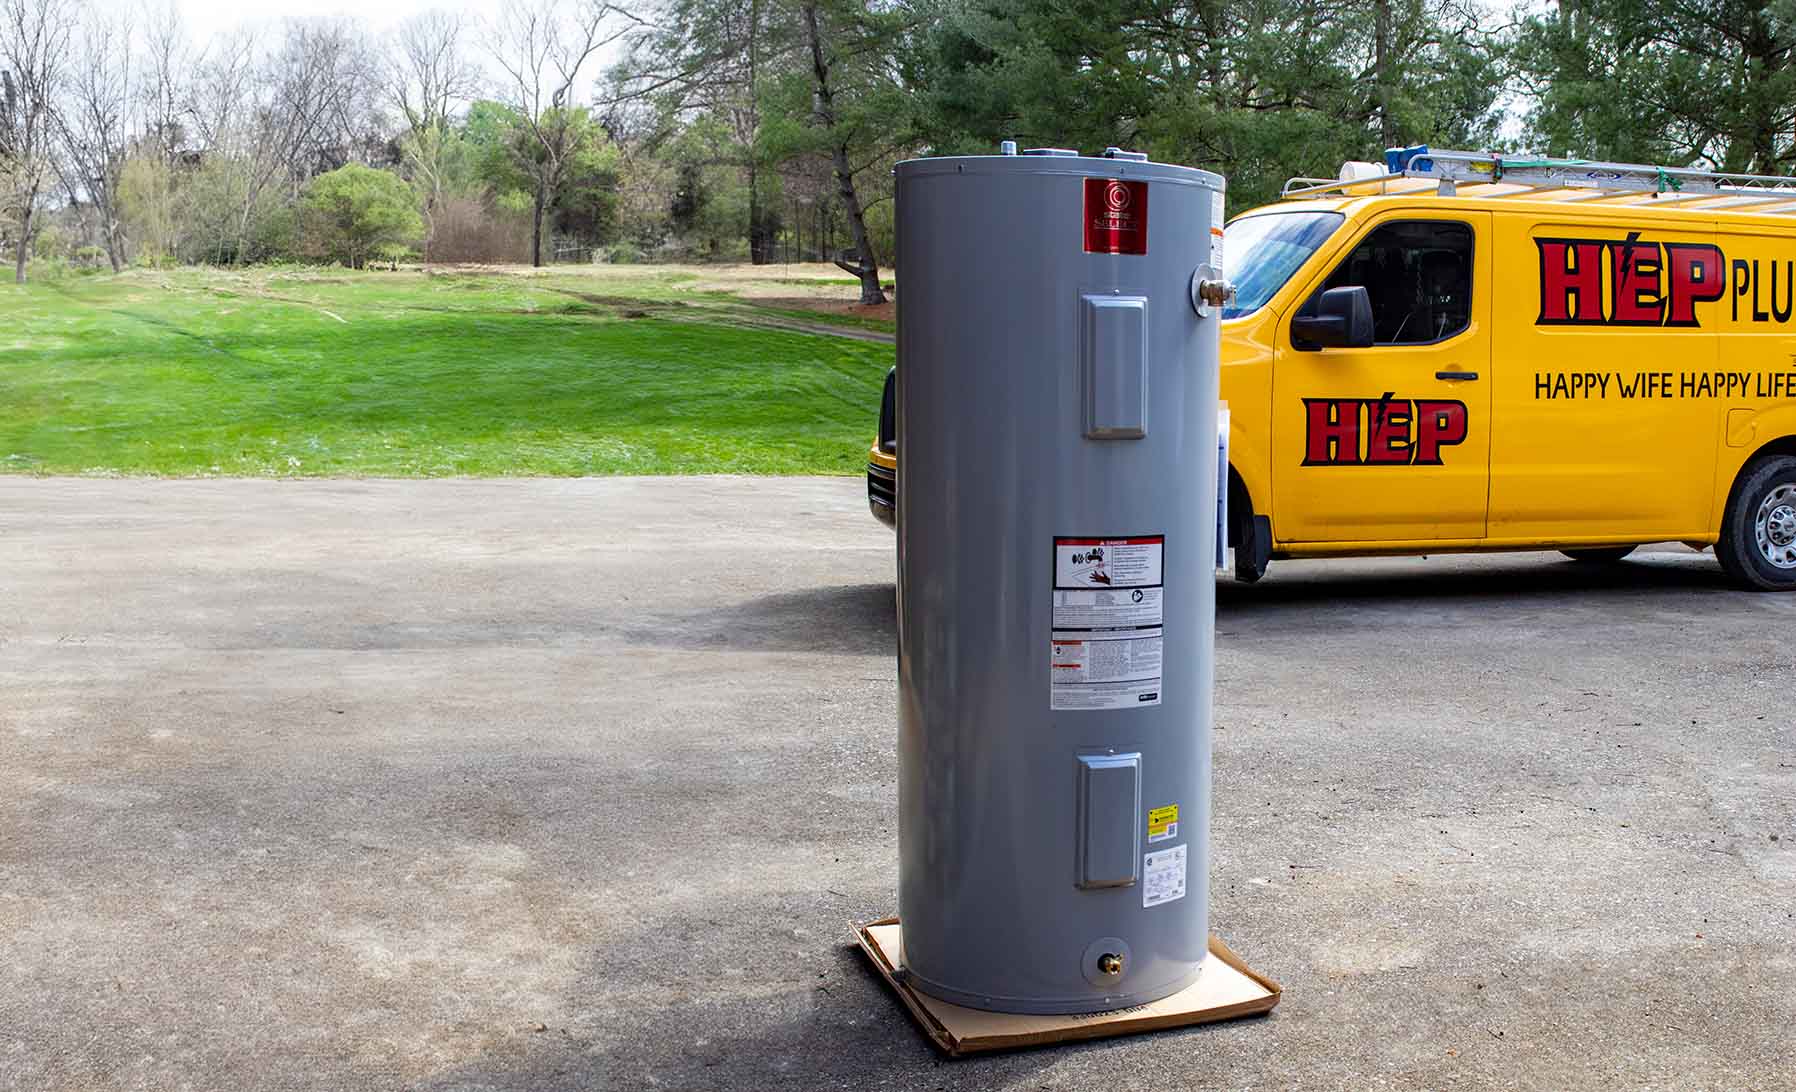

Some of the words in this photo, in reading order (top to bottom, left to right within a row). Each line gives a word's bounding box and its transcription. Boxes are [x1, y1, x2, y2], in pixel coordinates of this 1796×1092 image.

[1535, 372, 1610, 399] HAPPY
[1616, 372, 1673, 398] WIFE
[1680, 372, 1752, 398] HAPPY
[1756, 372, 1796, 398] LIFE
